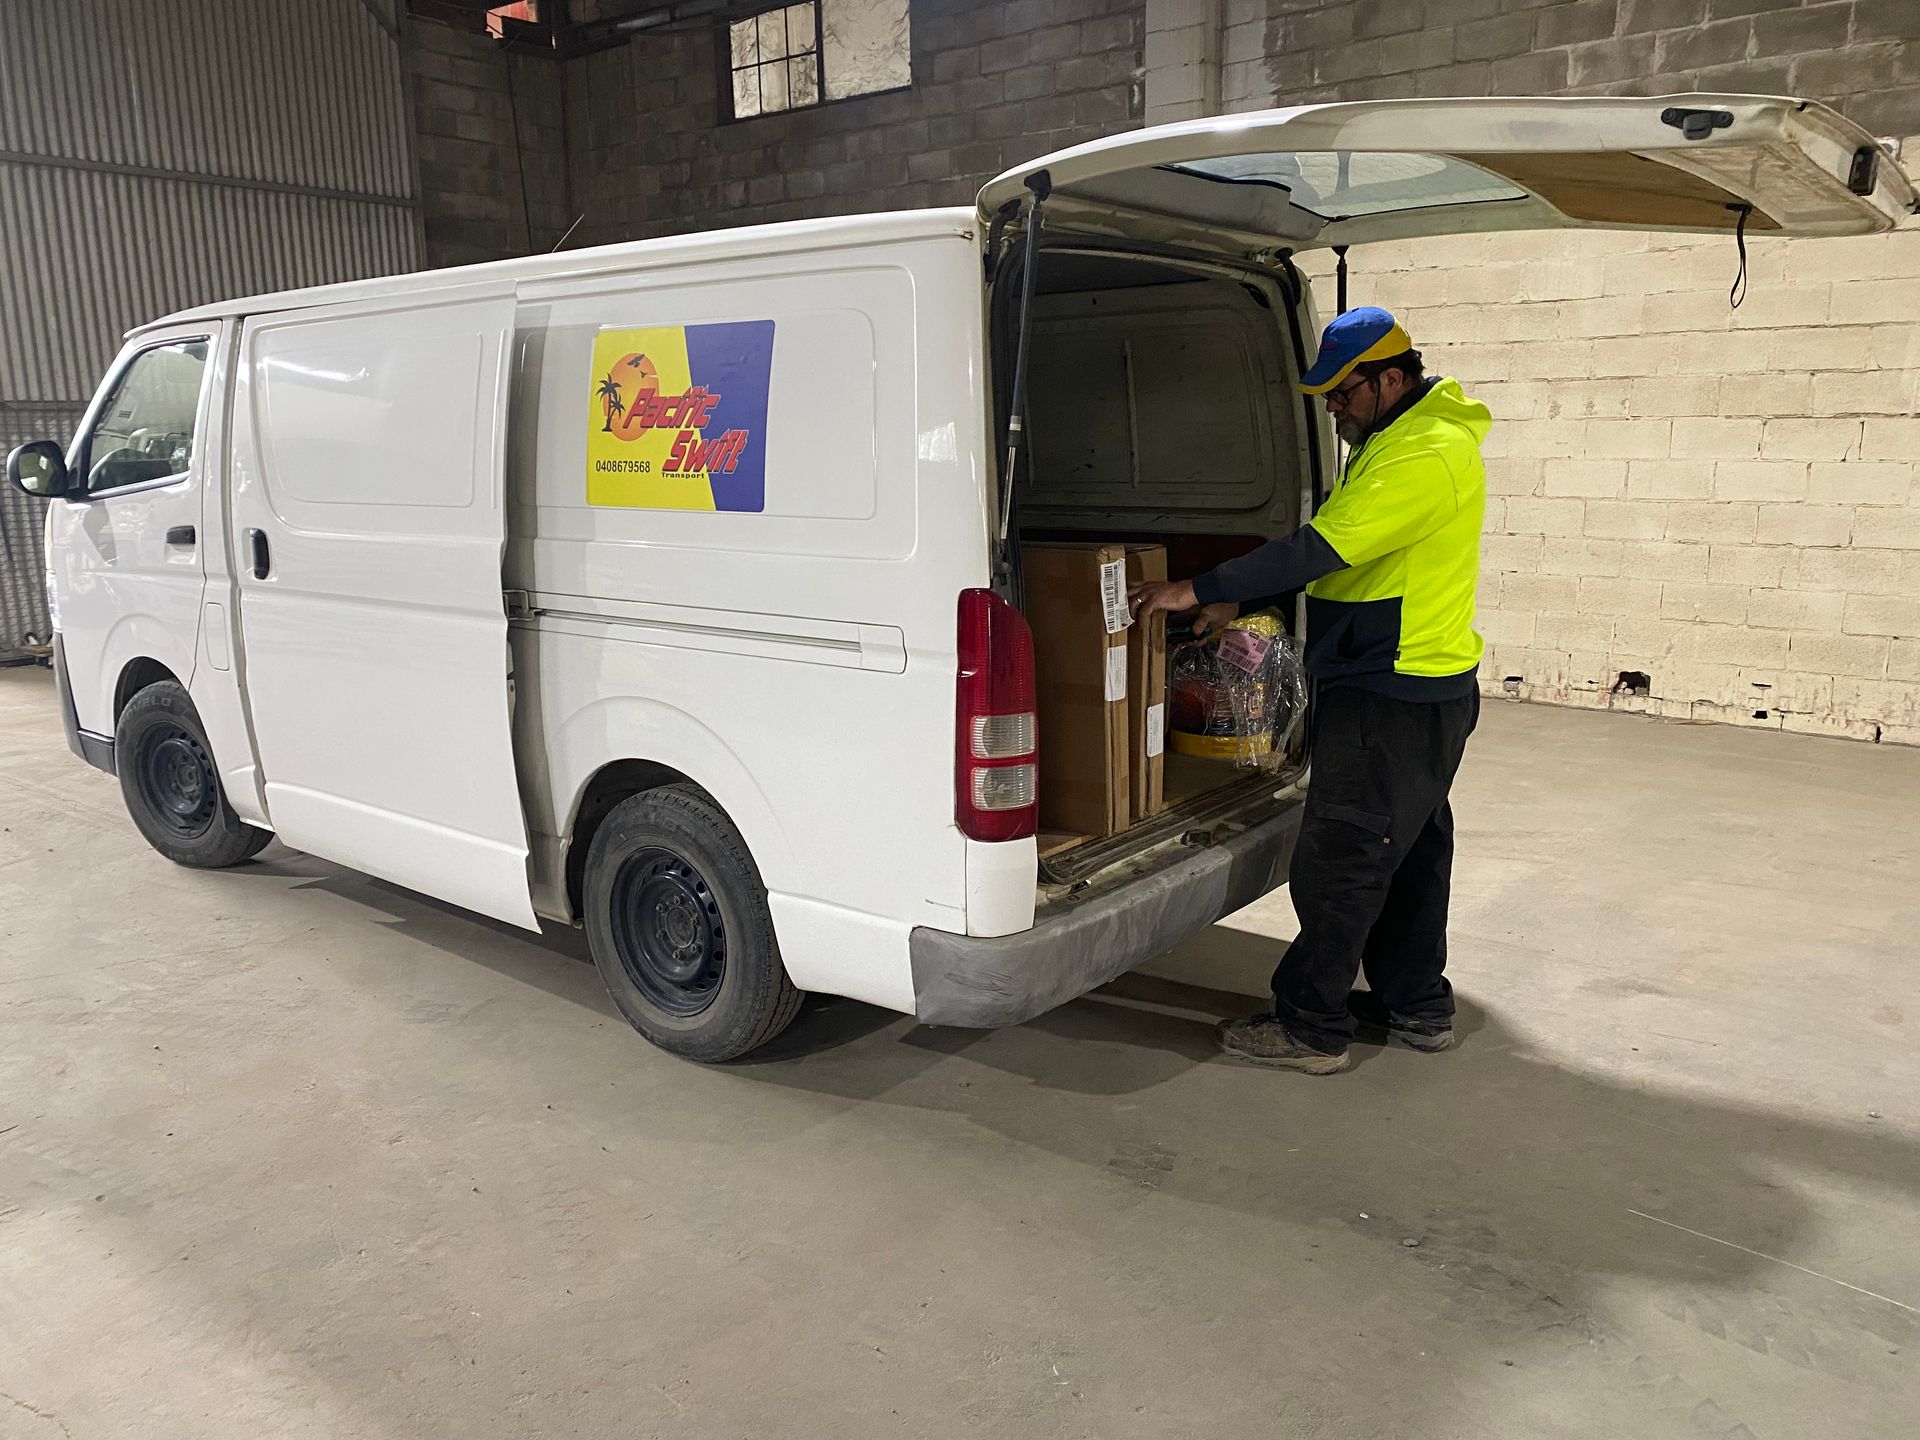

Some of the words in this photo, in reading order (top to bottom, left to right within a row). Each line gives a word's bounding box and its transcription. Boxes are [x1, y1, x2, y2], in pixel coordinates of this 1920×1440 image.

[623, 385, 721, 429] Pacific
[596, 460, 651, 473] 0408679568
[662, 430, 749, 474] Swift
